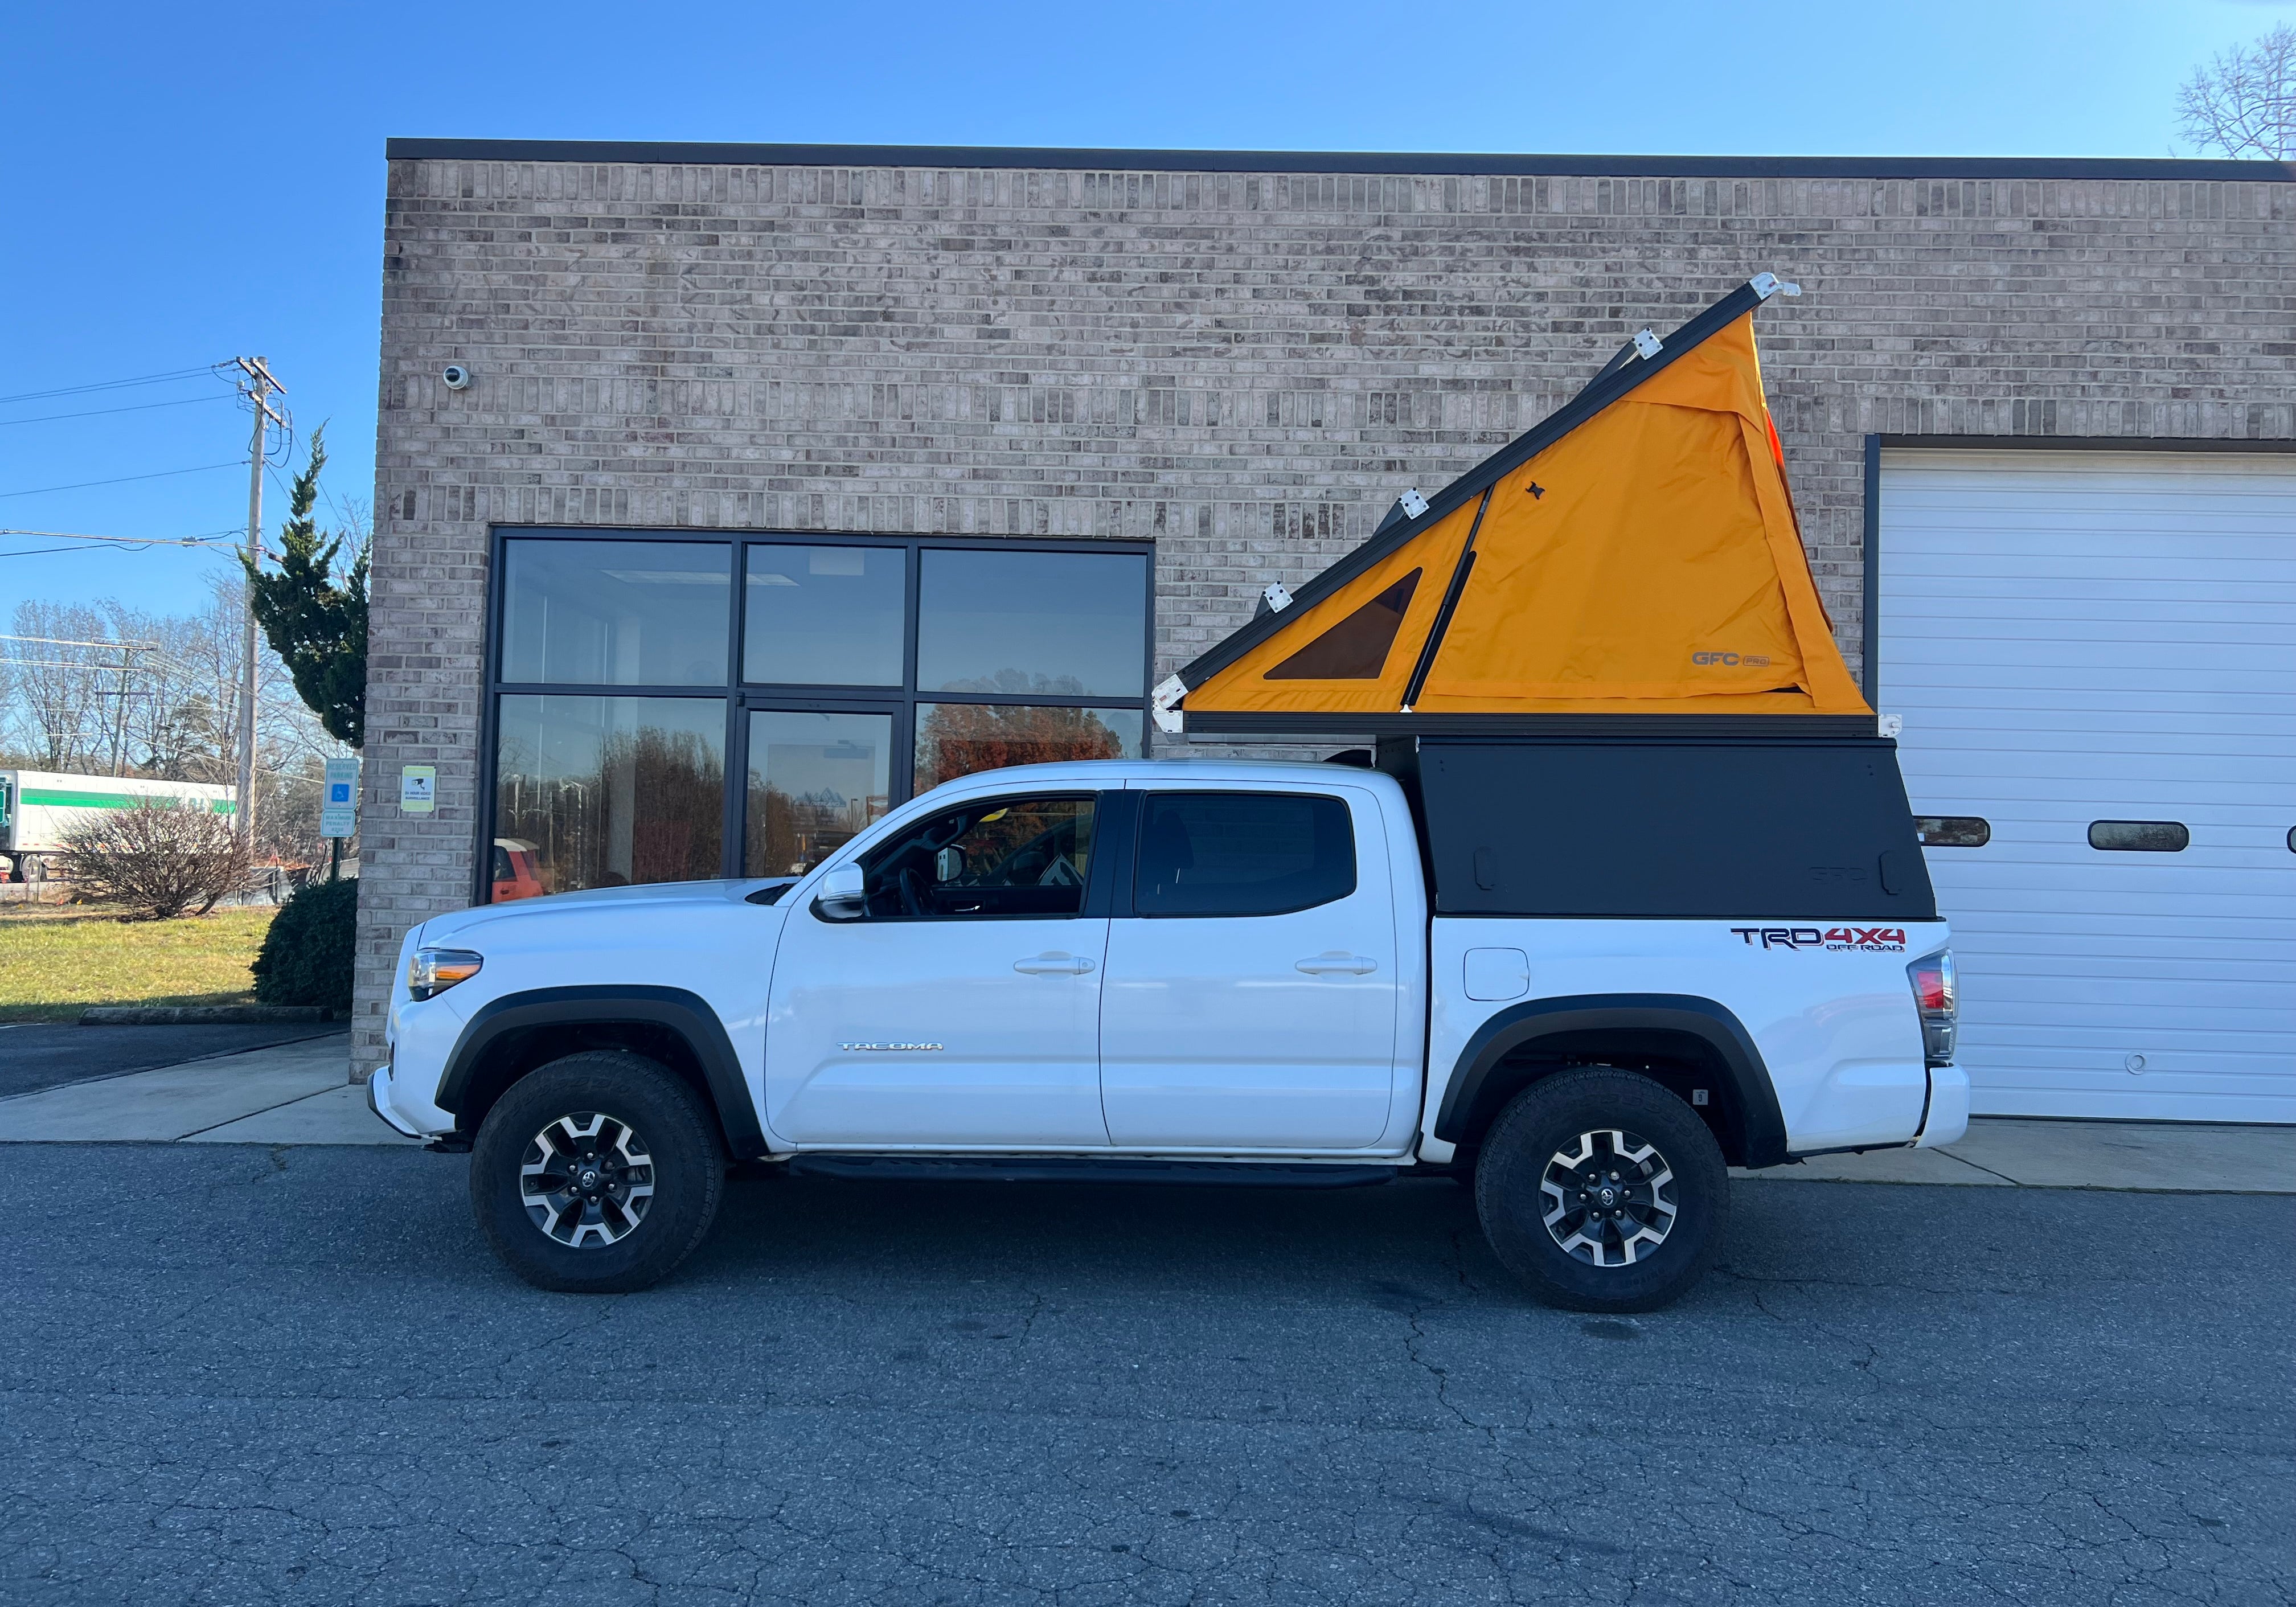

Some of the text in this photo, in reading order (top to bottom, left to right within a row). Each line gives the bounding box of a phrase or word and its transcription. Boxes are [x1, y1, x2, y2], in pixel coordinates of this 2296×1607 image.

[1692, 651, 1740, 666] GFC
[1730, 928, 1825, 951] TRD
[1860, 944, 1905, 953] ROAD
[837, 1042, 944, 1051] TACOMA
